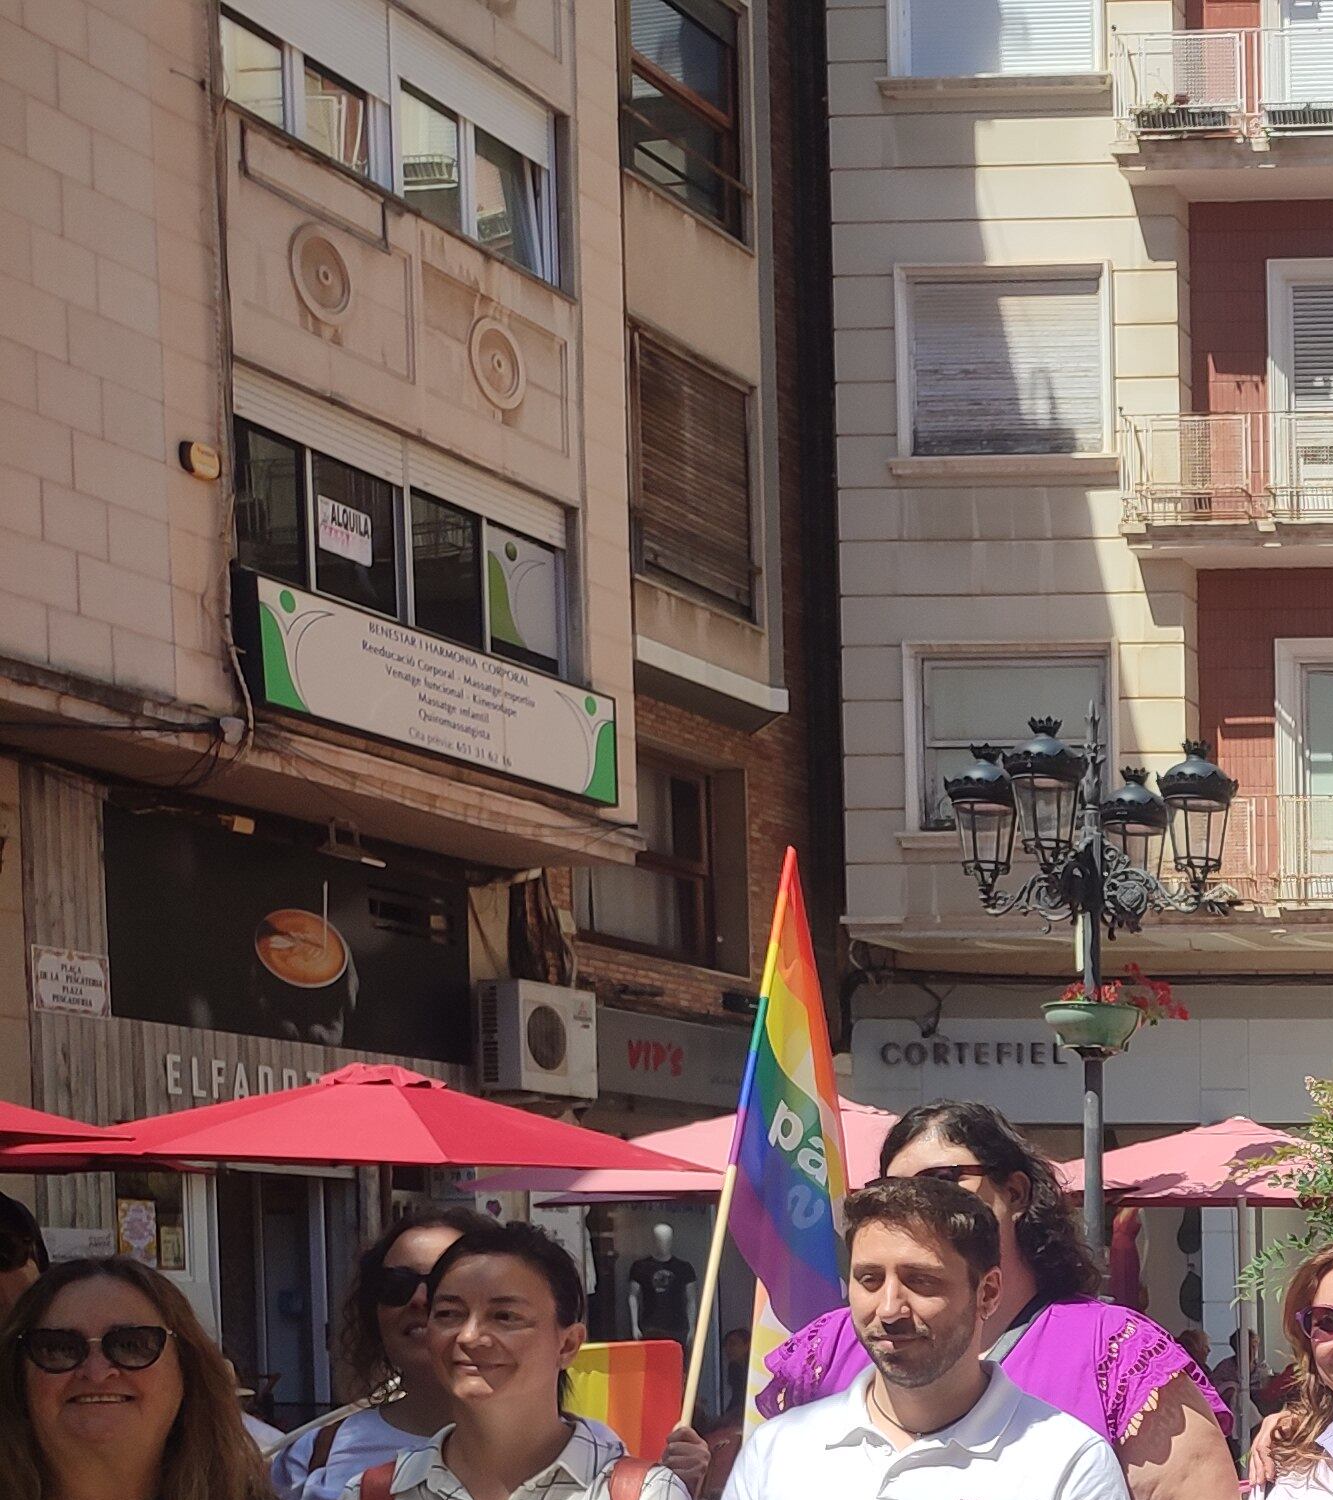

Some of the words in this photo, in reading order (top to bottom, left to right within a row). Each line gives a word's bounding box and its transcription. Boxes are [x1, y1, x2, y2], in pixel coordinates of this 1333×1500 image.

[331, 503, 370, 539] ALQUILA
[368, 622, 417, 646] BENESTAR
[425, 642, 478, 669] HARMONIA
[482, 662, 529, 686] CORPORAL
[362, 640, 415, 667] Reeducació
[418, 659, 455, 680] Corporal
[463, 675, 501, 697] Massatge
[418, 692, 456, 714] Massatge
[460, 707, 489, 723] infantil
[409, 727, 425, 741] Cita
[50, 972, 59, 980] LA
[62, 985, 83, 995] PLAZA
[52, 994, 93, 1007] PESCADERIA
[627, 1039, 684, 1077] VIP'S
[880, 1041, 1068, 1066] CORTEFIEL
